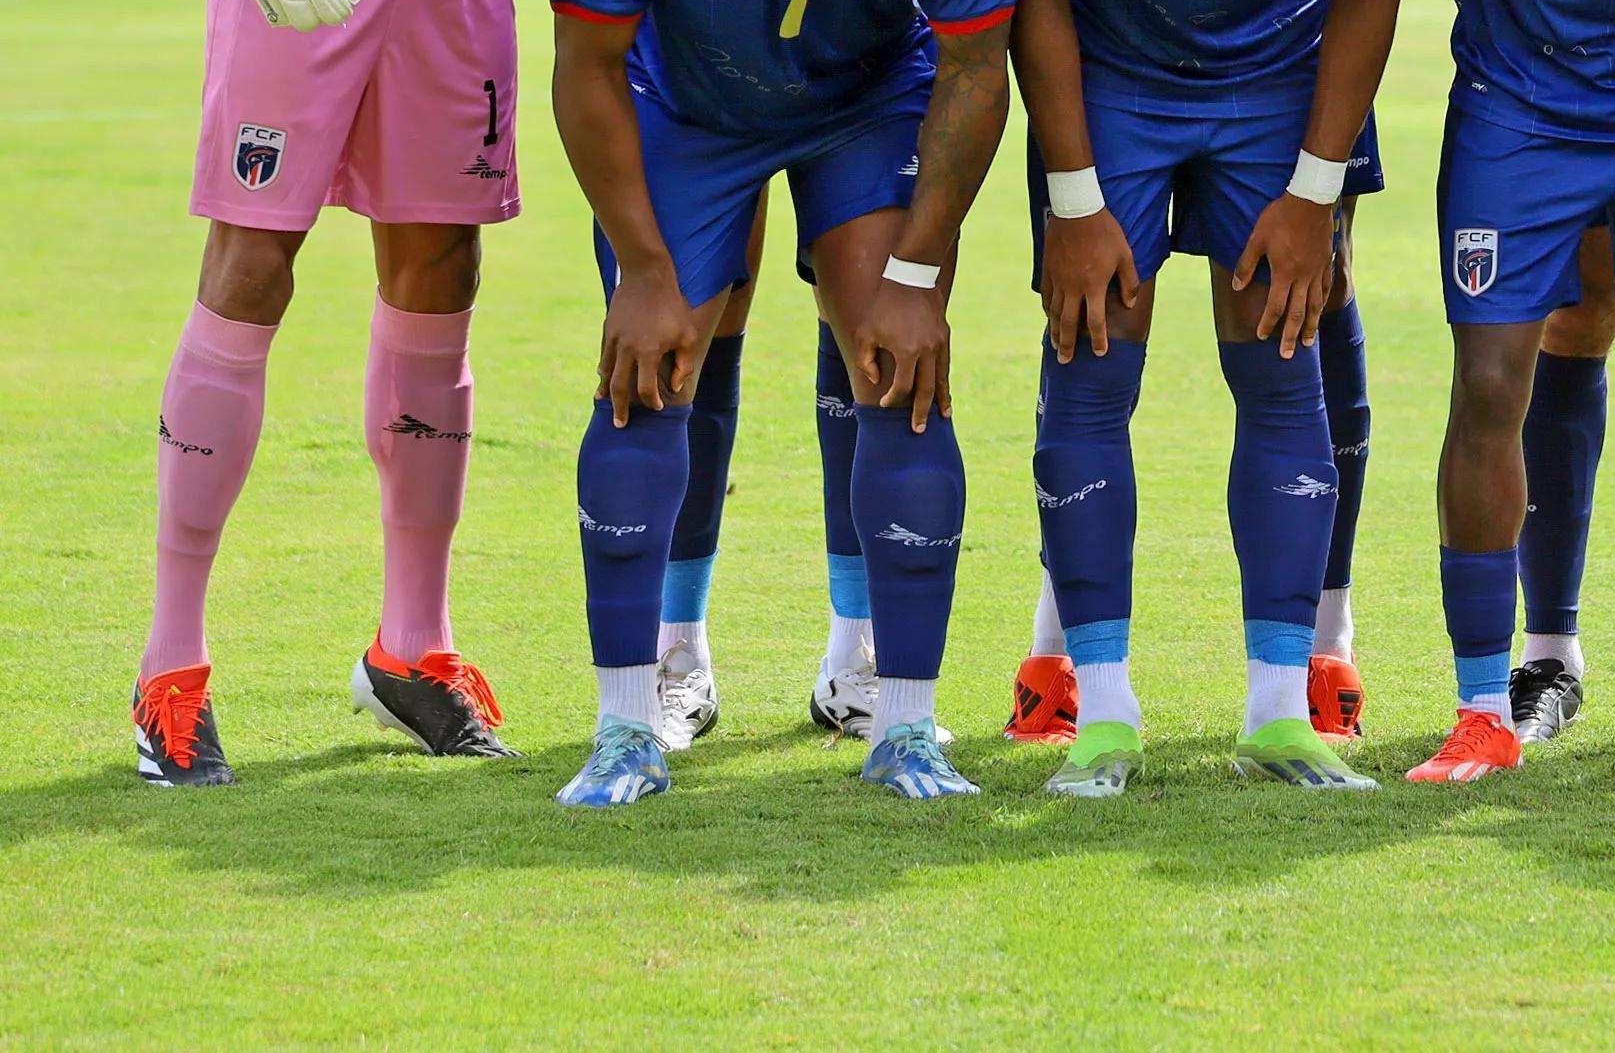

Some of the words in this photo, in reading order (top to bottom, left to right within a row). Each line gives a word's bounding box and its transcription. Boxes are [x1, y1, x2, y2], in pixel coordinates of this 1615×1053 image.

[484, 79, 498, 147] 1
[241, 126, 283, 141] FCF
[1347, 156, 1370, 169] mpo
[480, 169, 508, 179] temp
[1457, 232, 1493, 243] FCF
[829, 406, 857, 417] tem
[163, 435, 213, 456] tempo
[1040, 479, 1107, 509] tempo
[583, 521, 647, 536] tempo
